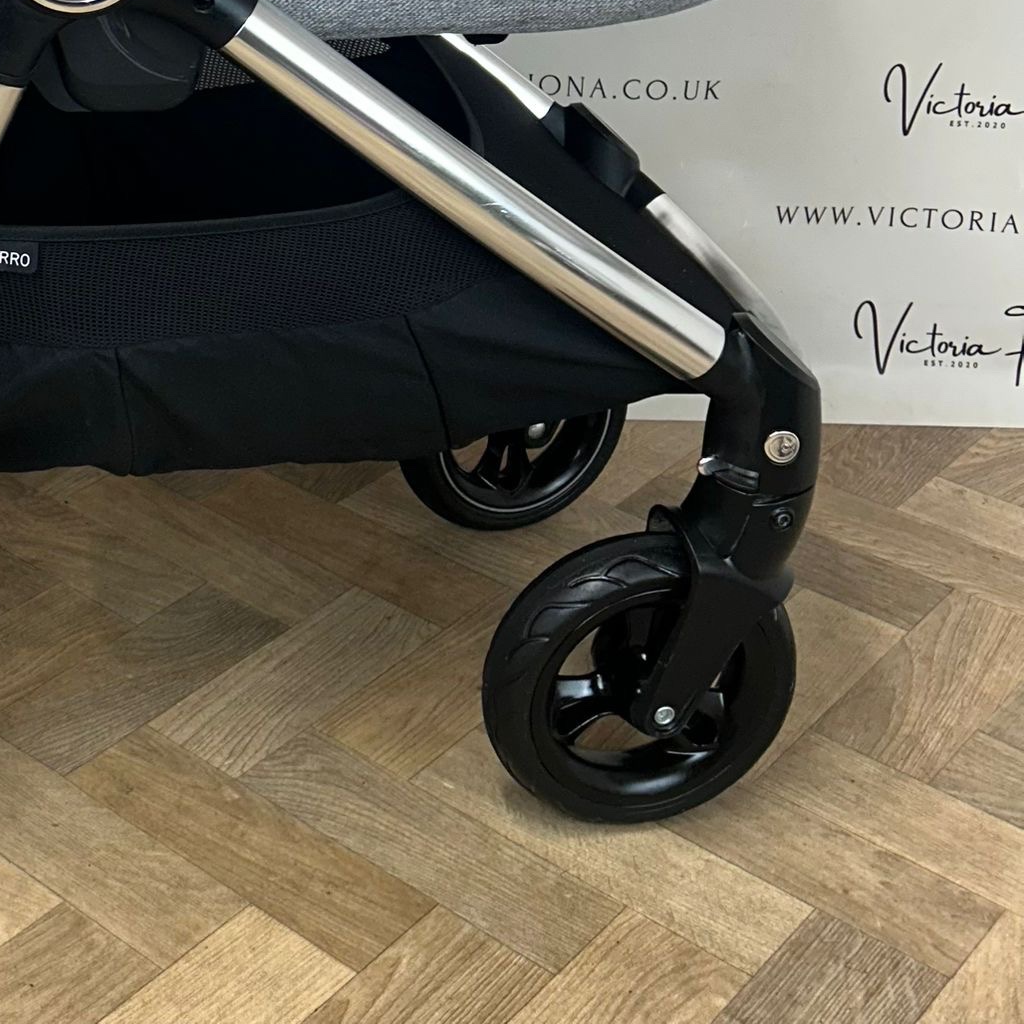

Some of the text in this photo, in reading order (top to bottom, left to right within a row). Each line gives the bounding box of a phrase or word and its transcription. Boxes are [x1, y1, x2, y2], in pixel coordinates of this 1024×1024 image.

[884, 62, 1024, 136] Victoria
[949, 120, 1006, 129] EST.2020
[775, 205, 1019, 234] WWW.VICTORIA
[854, 300, 1002, 375] Victoria
[924, 359, 979, 369] EST.2020
